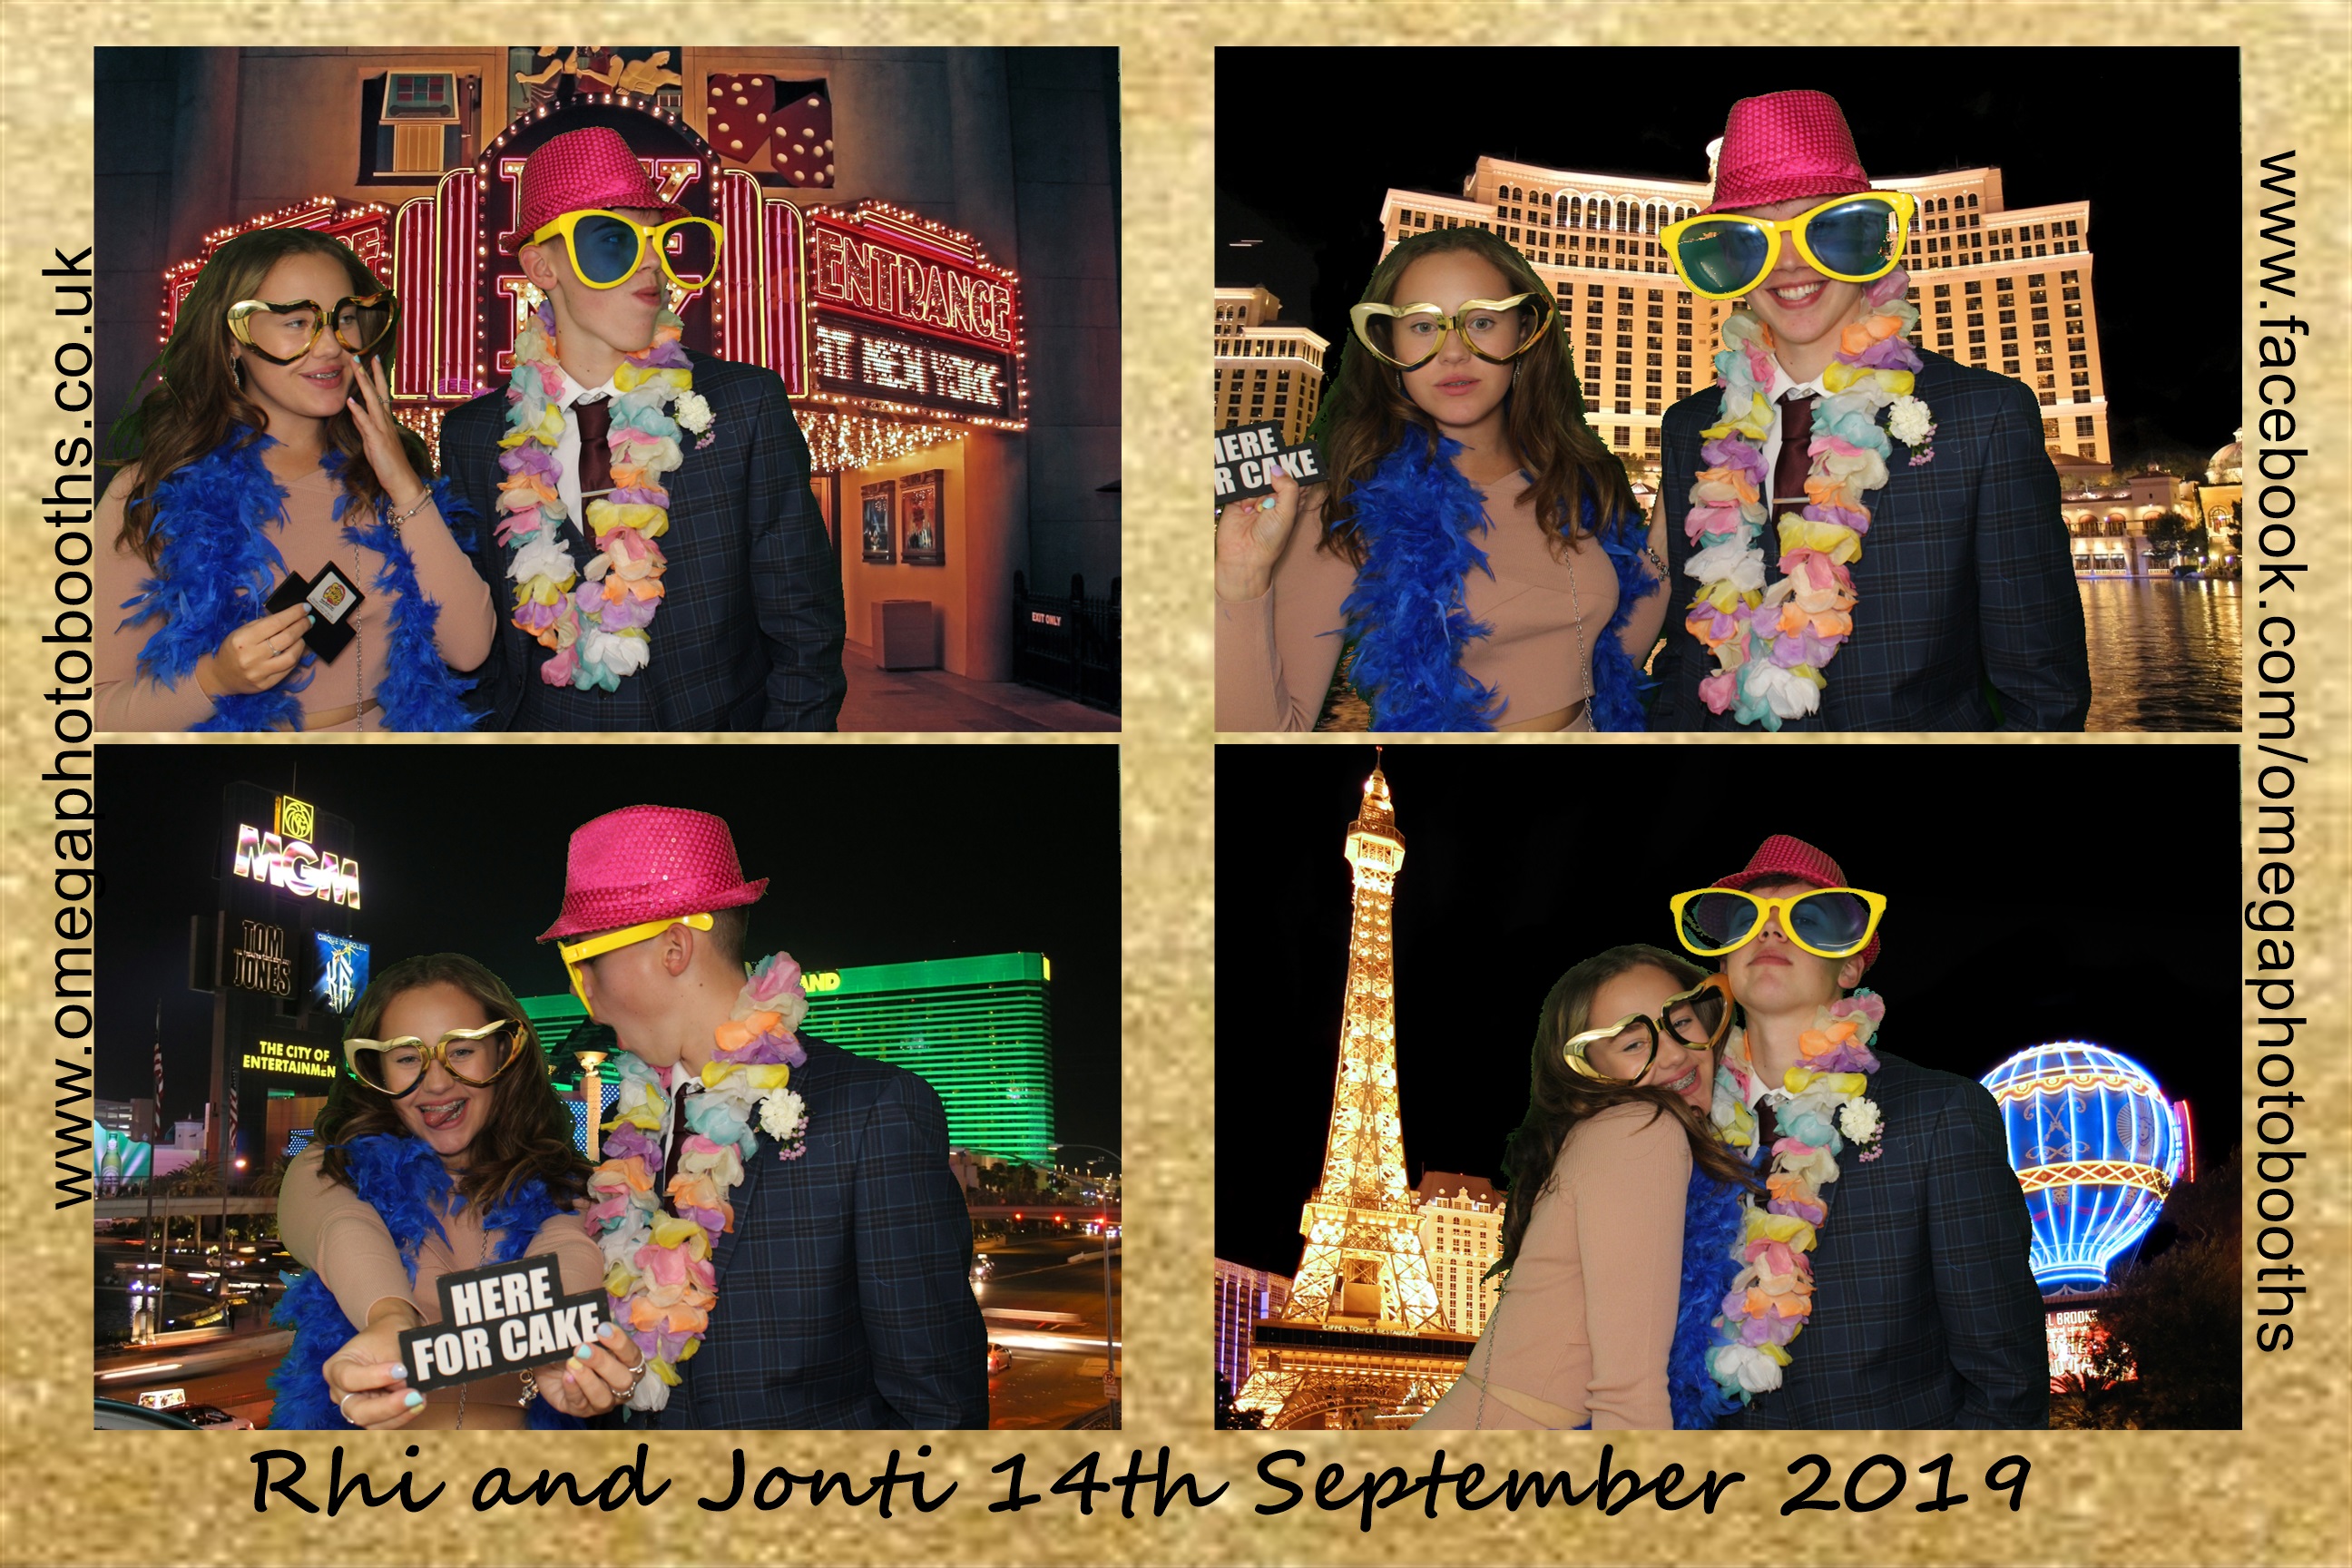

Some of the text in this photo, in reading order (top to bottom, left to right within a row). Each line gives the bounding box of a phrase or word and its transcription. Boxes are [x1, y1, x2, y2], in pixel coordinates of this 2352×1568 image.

[816, 227, 1011, 343] ENTRANCE
[1032, 612, 1062, 626] EXIT ONLY
[233, 823, 361, 910] MGM
[242, 919, 284, 957] TOM
[317, 933, 339, 946] CIRQUE
[232, 954, 291, 996] JONES
[260, 1041, 330, 1063] THE CITY OF
[450, 1267, 554, 1327] HERE
[411, 1302, 600, 1382] FOR CAKE
[1321, 1324, 1420, 1338] EIFFEL TOWER RESTAURANT
